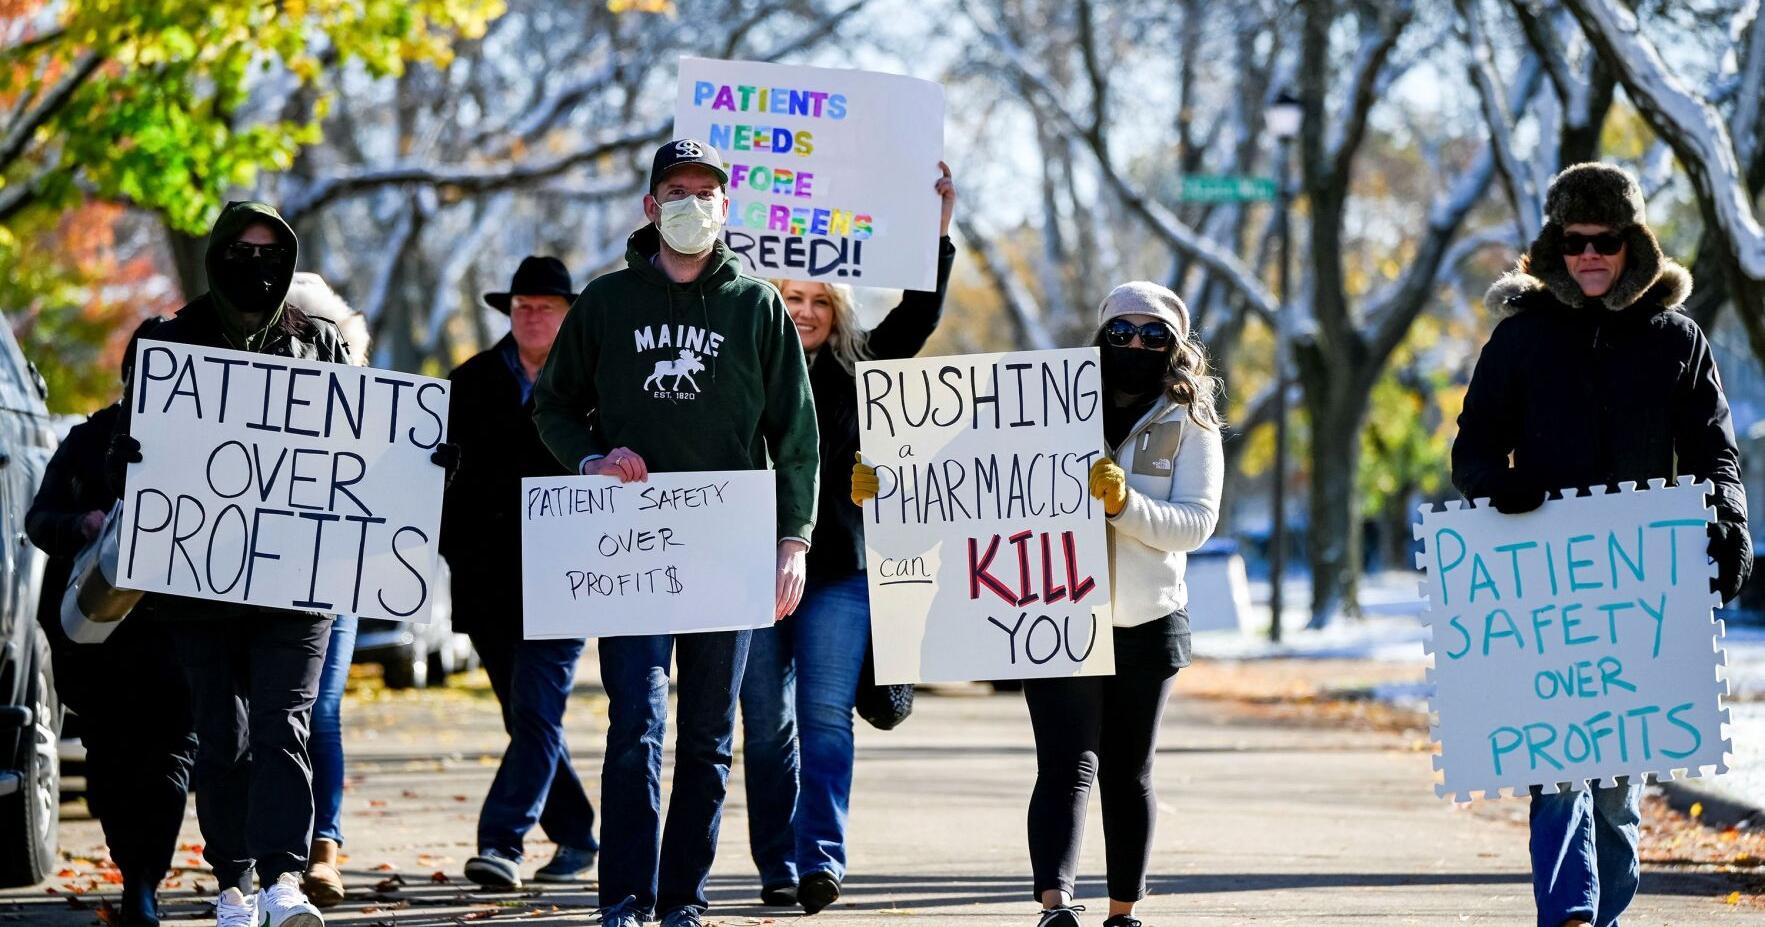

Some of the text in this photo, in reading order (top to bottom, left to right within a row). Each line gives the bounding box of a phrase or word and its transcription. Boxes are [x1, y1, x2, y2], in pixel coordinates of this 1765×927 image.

[693, 80, 848, 120] PATIENTS
[709, 123, 815, 158] NEEDS
[723, 162, 814, 199] FORE
[723, 200, 873, 241] LGREENS
[724, 230, 862, 277] REED!!
[634, 323, 725, 358] MAINE
[138, 346, 446, 450] PATIENTS
[653, 391, 695, 400] EST. 1820
[863, 359, 1099, 437] RUSHING
[898, 443, 914, 459] a
[206, 440, 373, 517] OVER
[528, 481, 730, 520] PATIENT SAFETY
[873, 450, 1100, 525] PHARMACIST
[127, 488, 429, 617] PROFITS
[598, 527, 685, 557] OVER
[1435, 519, 1708, 606] PATIENT
[565, 565, 684, 600] PROFIT$
[879, 529, 1097, 608] can KILL
[987, 612, 1097, 665] YOU
[1446, 592, 1667, 660] SAFETY
[1534, 656, 1637, 700] OVER
[1488, 702, 1702, 777] PROFITS
